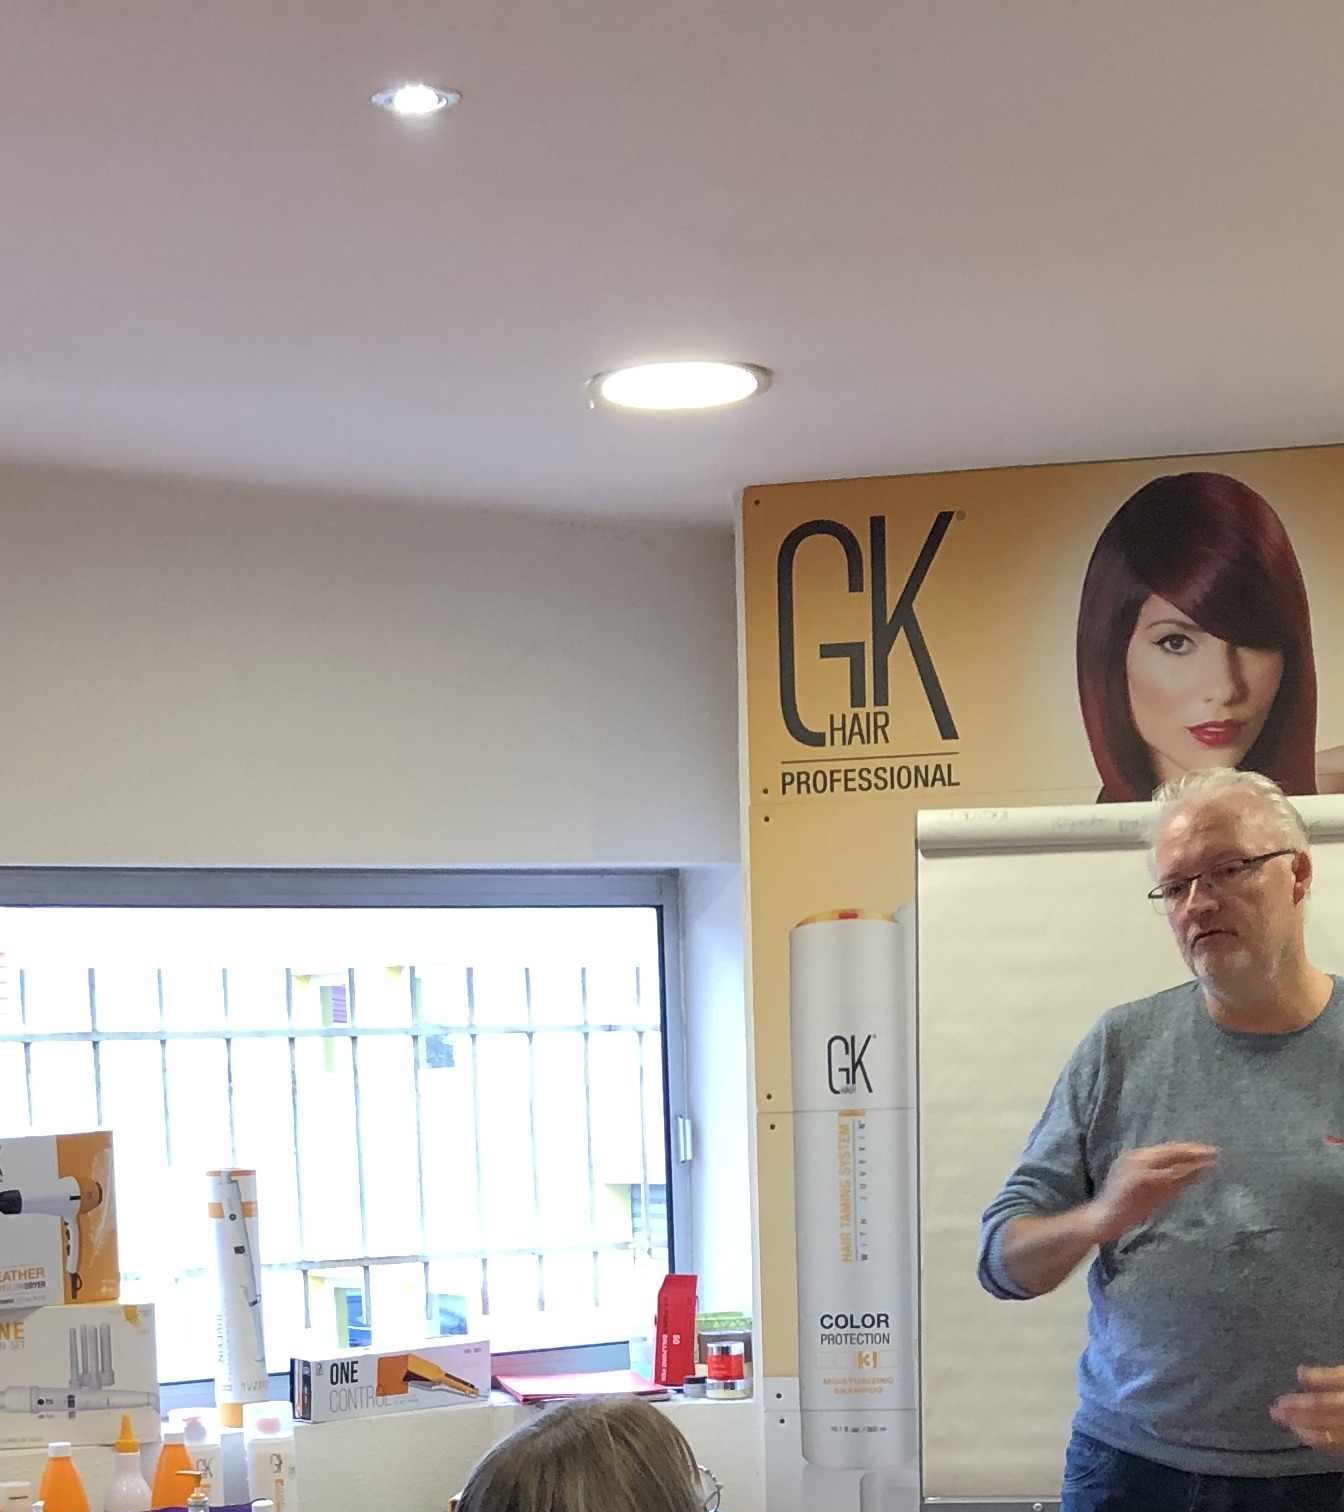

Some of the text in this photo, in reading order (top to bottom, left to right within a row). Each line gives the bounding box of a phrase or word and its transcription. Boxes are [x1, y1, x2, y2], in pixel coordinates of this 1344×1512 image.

[778, 510, 958, 748] GK
[829, 711, 891, 747] HAIR
[781, 762, 961, 795] PROFESSIONAL
[827, 1034, 873, 1095] GK
[820, 1313, 890, 1329] COLOR
[820, 1332, 890, 1345] PROTECTION
[330, 1361, 358, 1385] ONE
[329, 1385, 392, 1413] CONTROL
